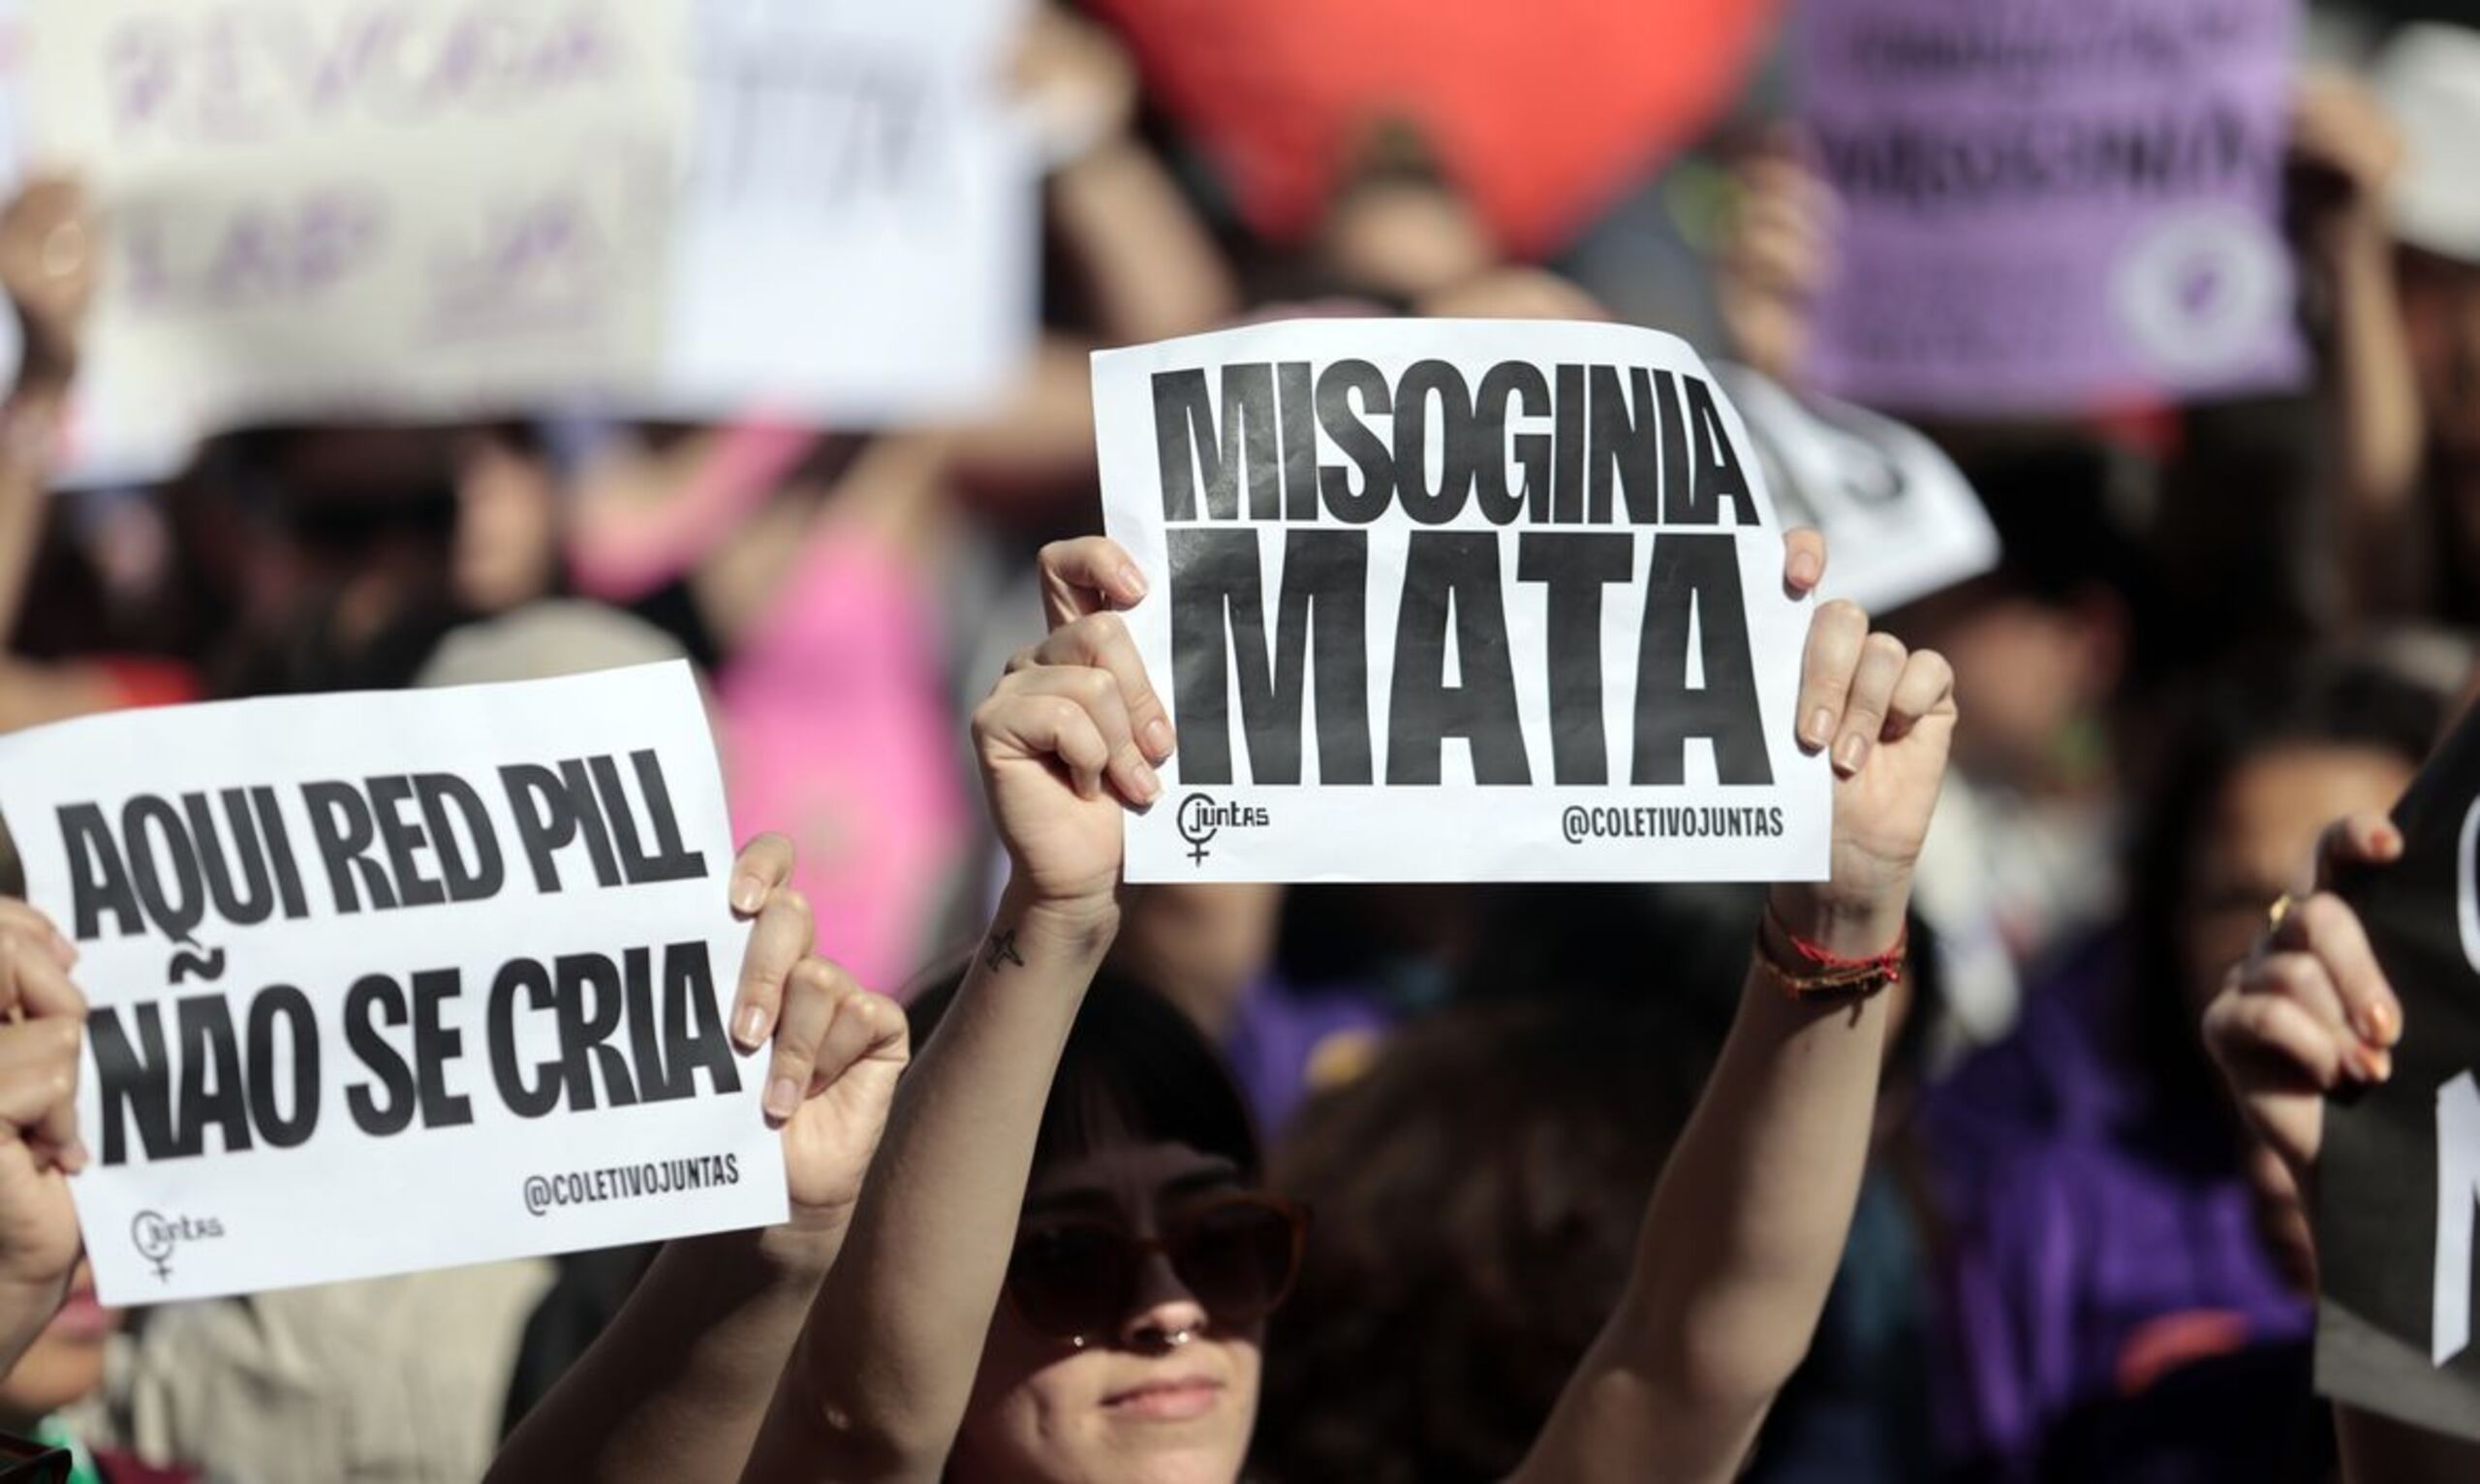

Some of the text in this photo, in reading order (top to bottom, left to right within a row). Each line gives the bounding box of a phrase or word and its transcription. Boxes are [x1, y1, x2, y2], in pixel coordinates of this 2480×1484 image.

[1151, 358, 1761, 526] MISOGINIA
[1166, 527, 1775, 787] MATA
[55, 749, 709, 949] AQUI RED PILL
[1562, 805, 1784, 845] @COLETIVOJUNTAS
[79, 940, 743, 1167] NÃO SE CRIA
[523, 1152, 739, 1217] @COLETIVOJUNTAS
